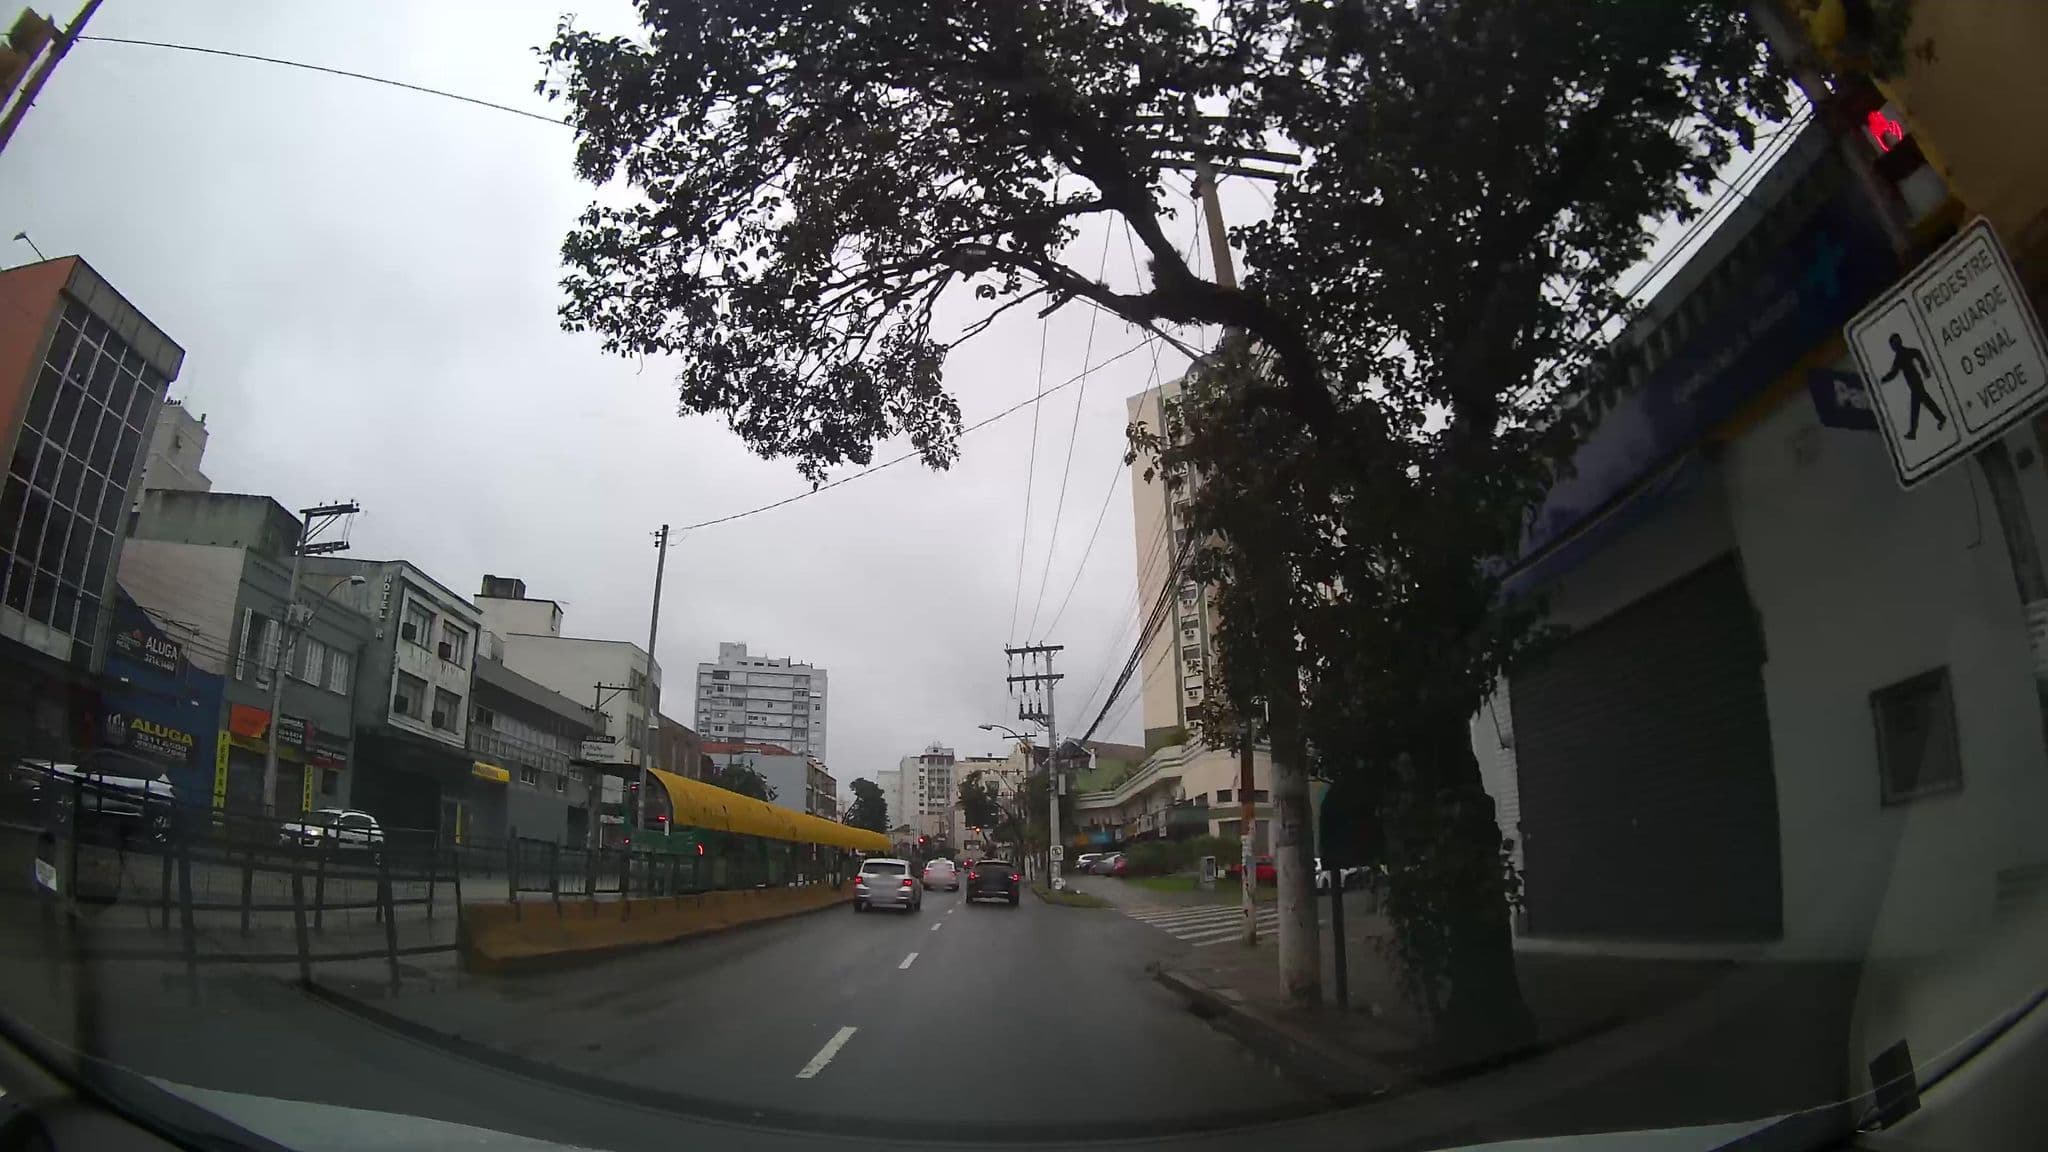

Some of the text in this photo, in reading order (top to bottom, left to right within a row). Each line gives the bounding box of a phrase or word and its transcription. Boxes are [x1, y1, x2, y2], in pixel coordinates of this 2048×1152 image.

[1922, 249, 1994, 314] PEDESTRE
[1942, 285, 2007, 345] AGUARDE
[1960, 328, 2017, 376] O SINAL
[1976, 364, 2029, 409] VERDE
[378, 573, 392, 620] HOTEL
[144, 636, 178, 660] ALUGA
[130, 718, 193, 747] ALUGA
